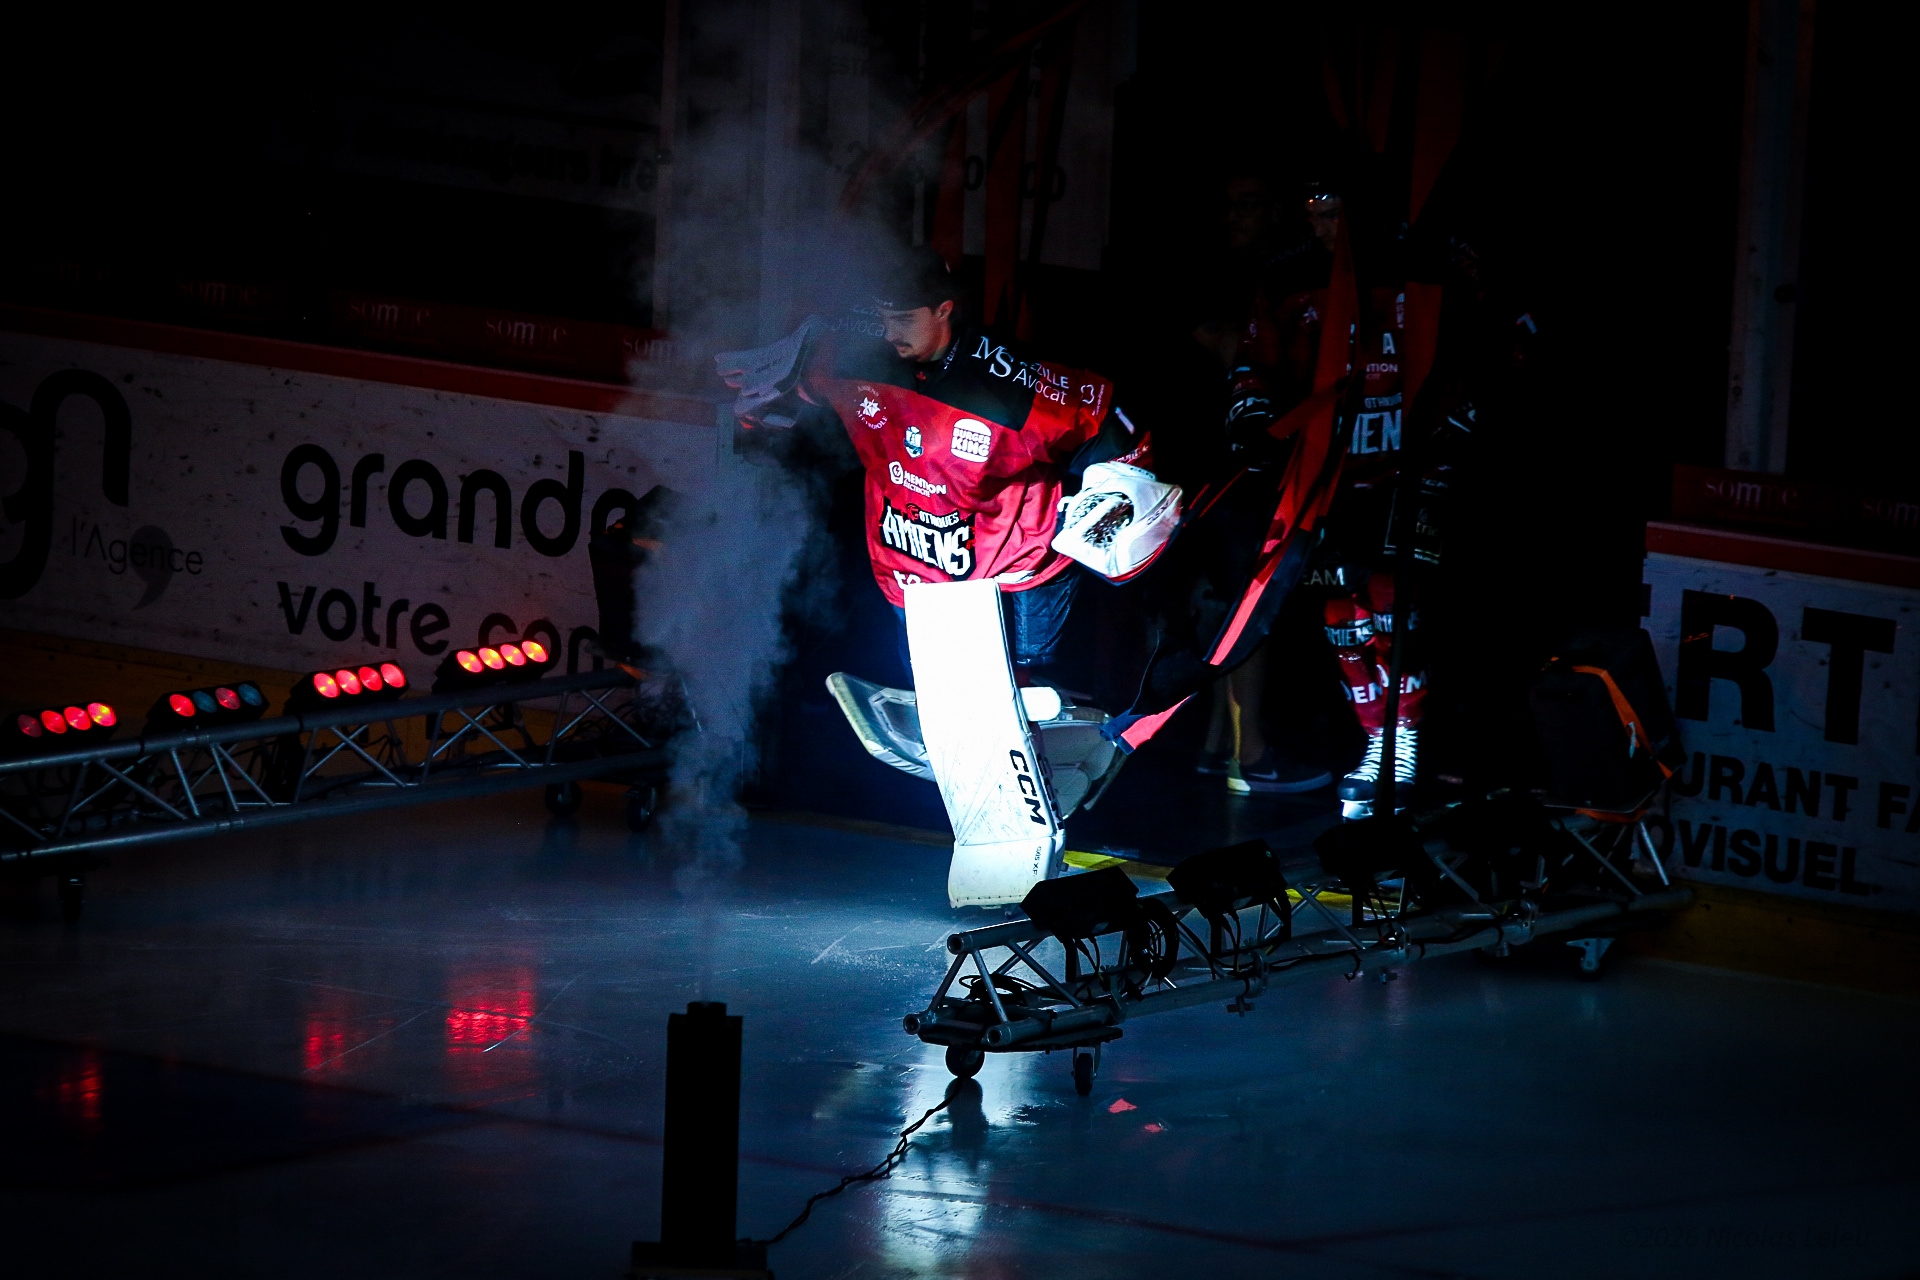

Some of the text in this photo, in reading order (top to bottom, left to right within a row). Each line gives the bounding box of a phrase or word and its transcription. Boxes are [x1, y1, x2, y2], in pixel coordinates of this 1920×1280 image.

[1012, 367, 1068, 406] Avocat
[951, 436, 990, 457] KING
[953, 428, 991, 446] BURGER
[881, 505, 971, 577] AMIENS
[277, 581, 450, 657] votre
[1009, 750, 1047, 826] CCM
